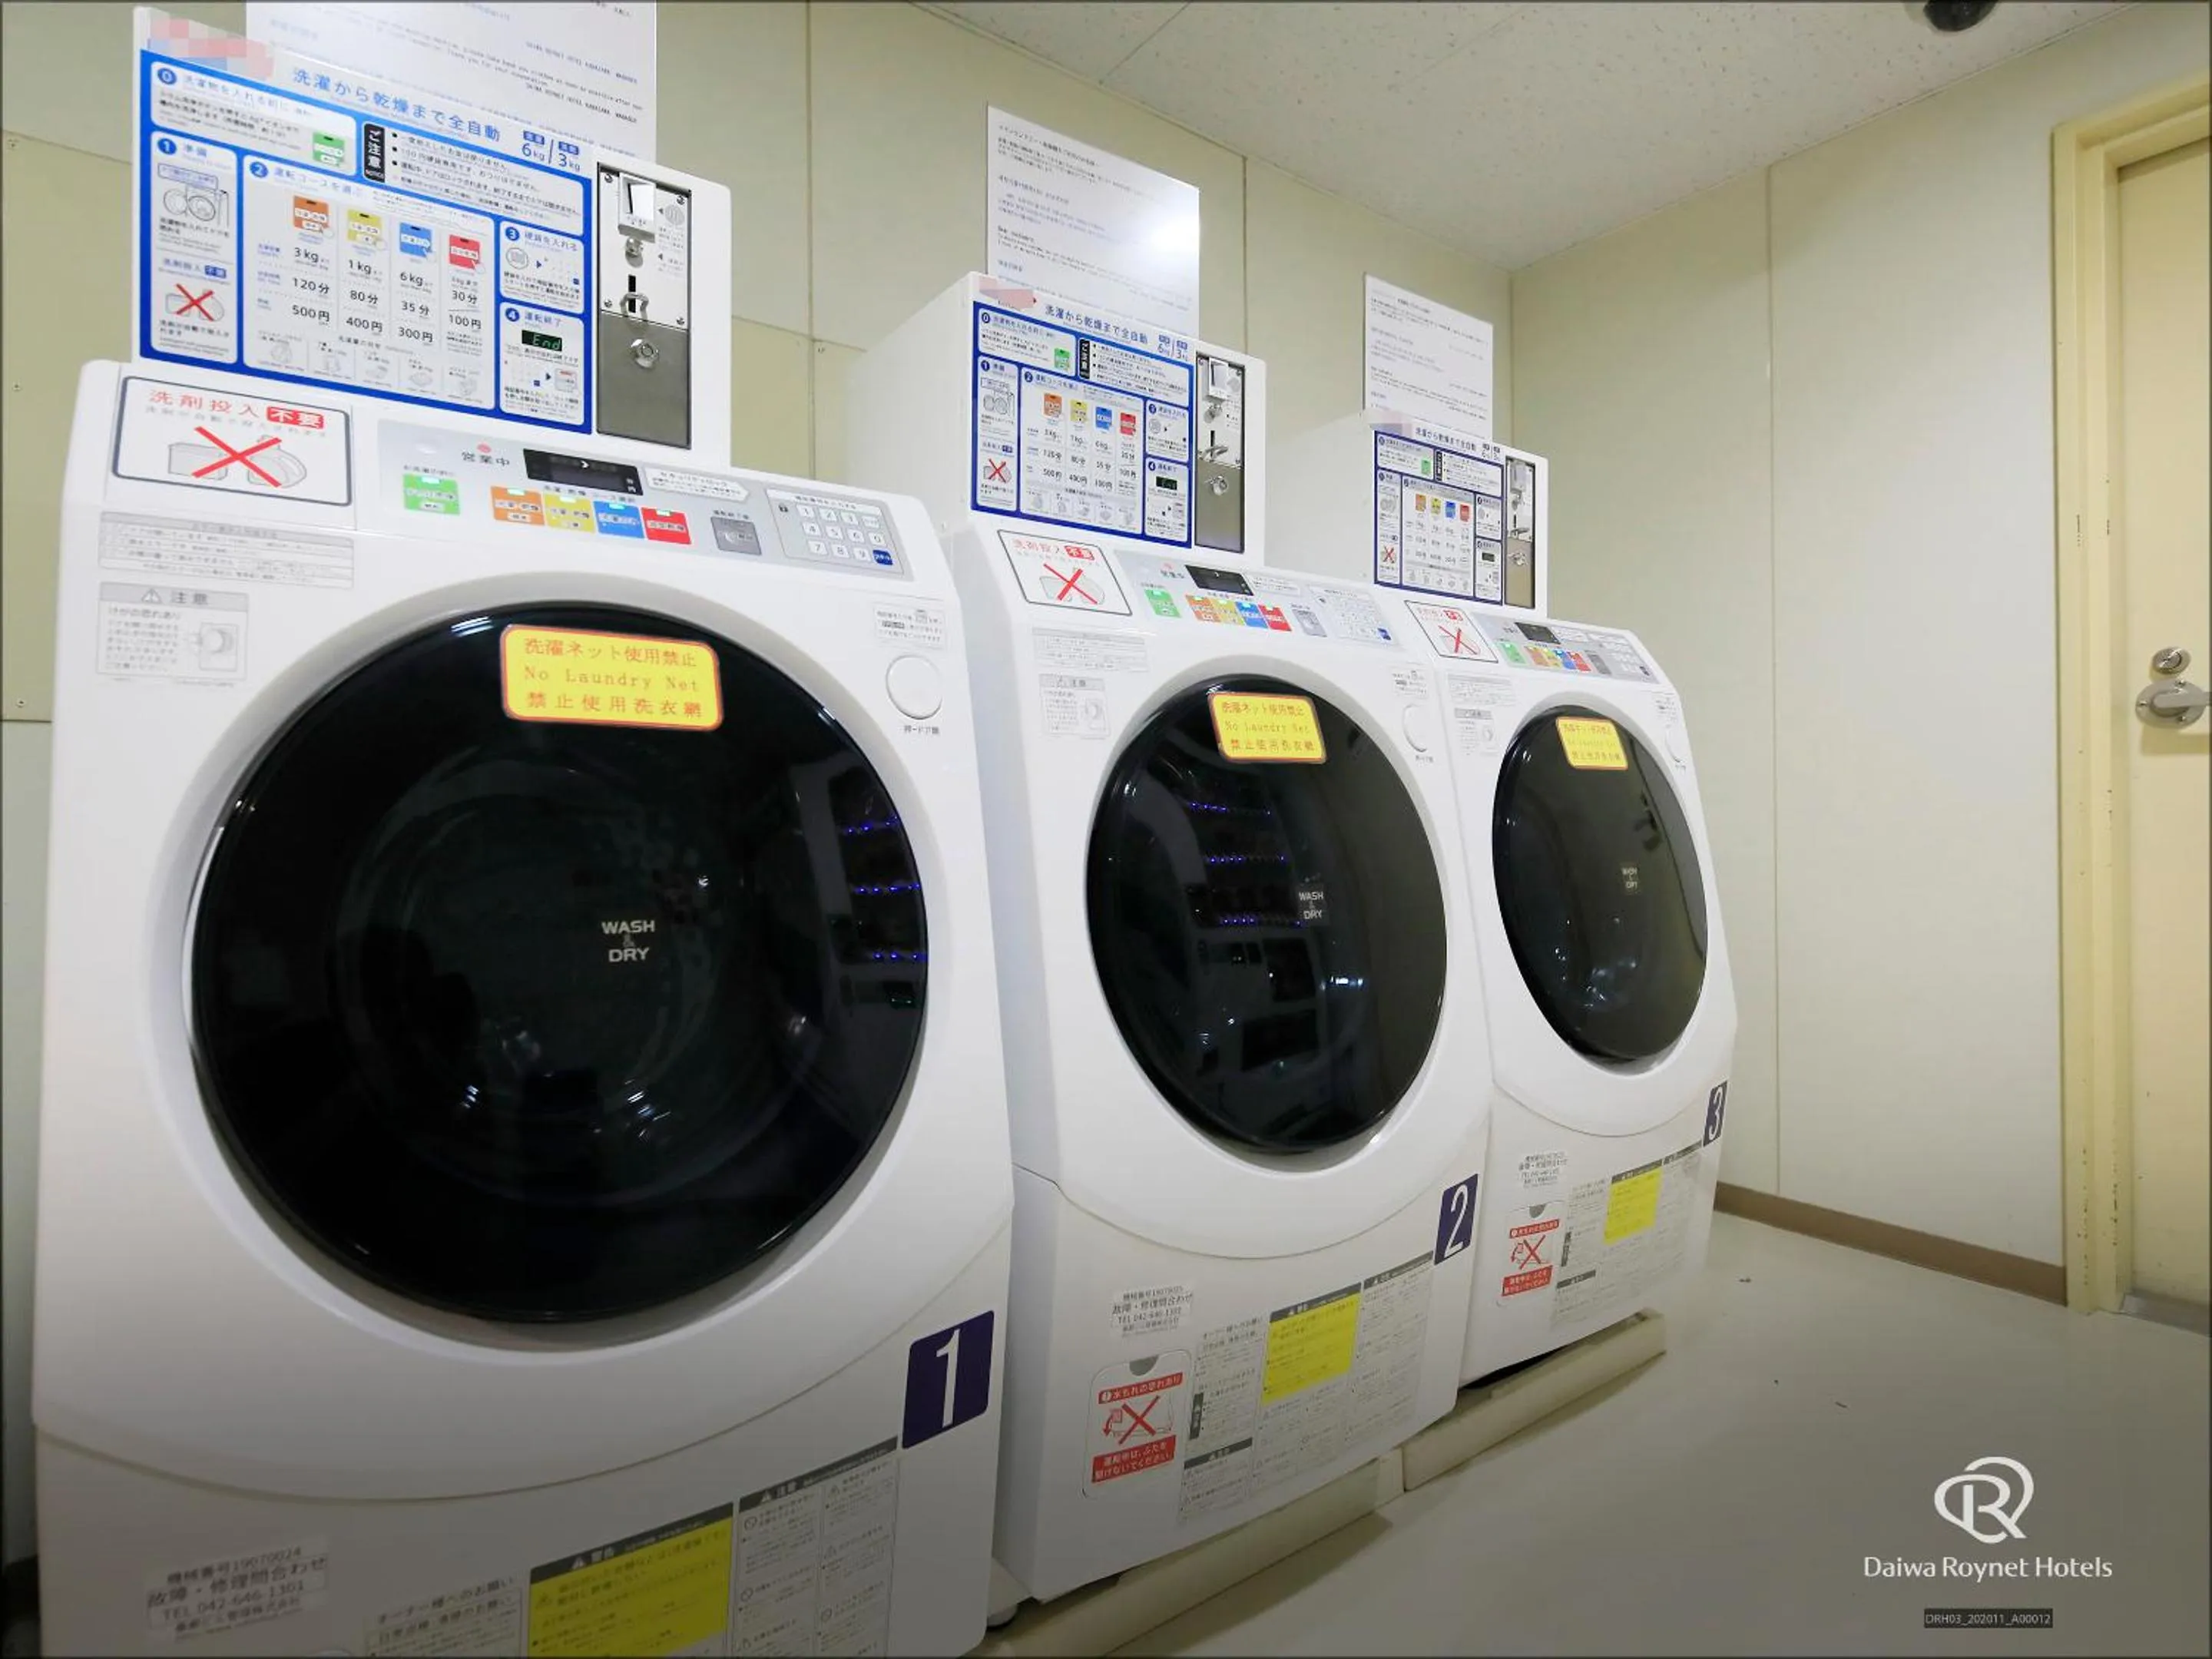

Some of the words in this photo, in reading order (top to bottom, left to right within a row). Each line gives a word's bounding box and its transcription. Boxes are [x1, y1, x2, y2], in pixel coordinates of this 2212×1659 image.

[293, 68, 501, 143] 洗濯から乾燥まで全自動
[525, 637, 697, 667] 洗濯ネット使用禁止
[525, 666, 549, 681] No
[565, 668, 652, 690] Laundry
[667, 676, 699, 693] Net
[528, 691, 702, 718] 禁止使用洗衣網
[1298, 891, 1324, 901] WASH
[601, 919, 655, 935] WASH
[1303, 909, 1322, 919] DRY
[609, 946, 650, 962] DRY
[1709, 1086, 1723, 1140] 3
[1444, 1184, 1469, 1260] 2
[935, 1328, 961, 1429] 1
